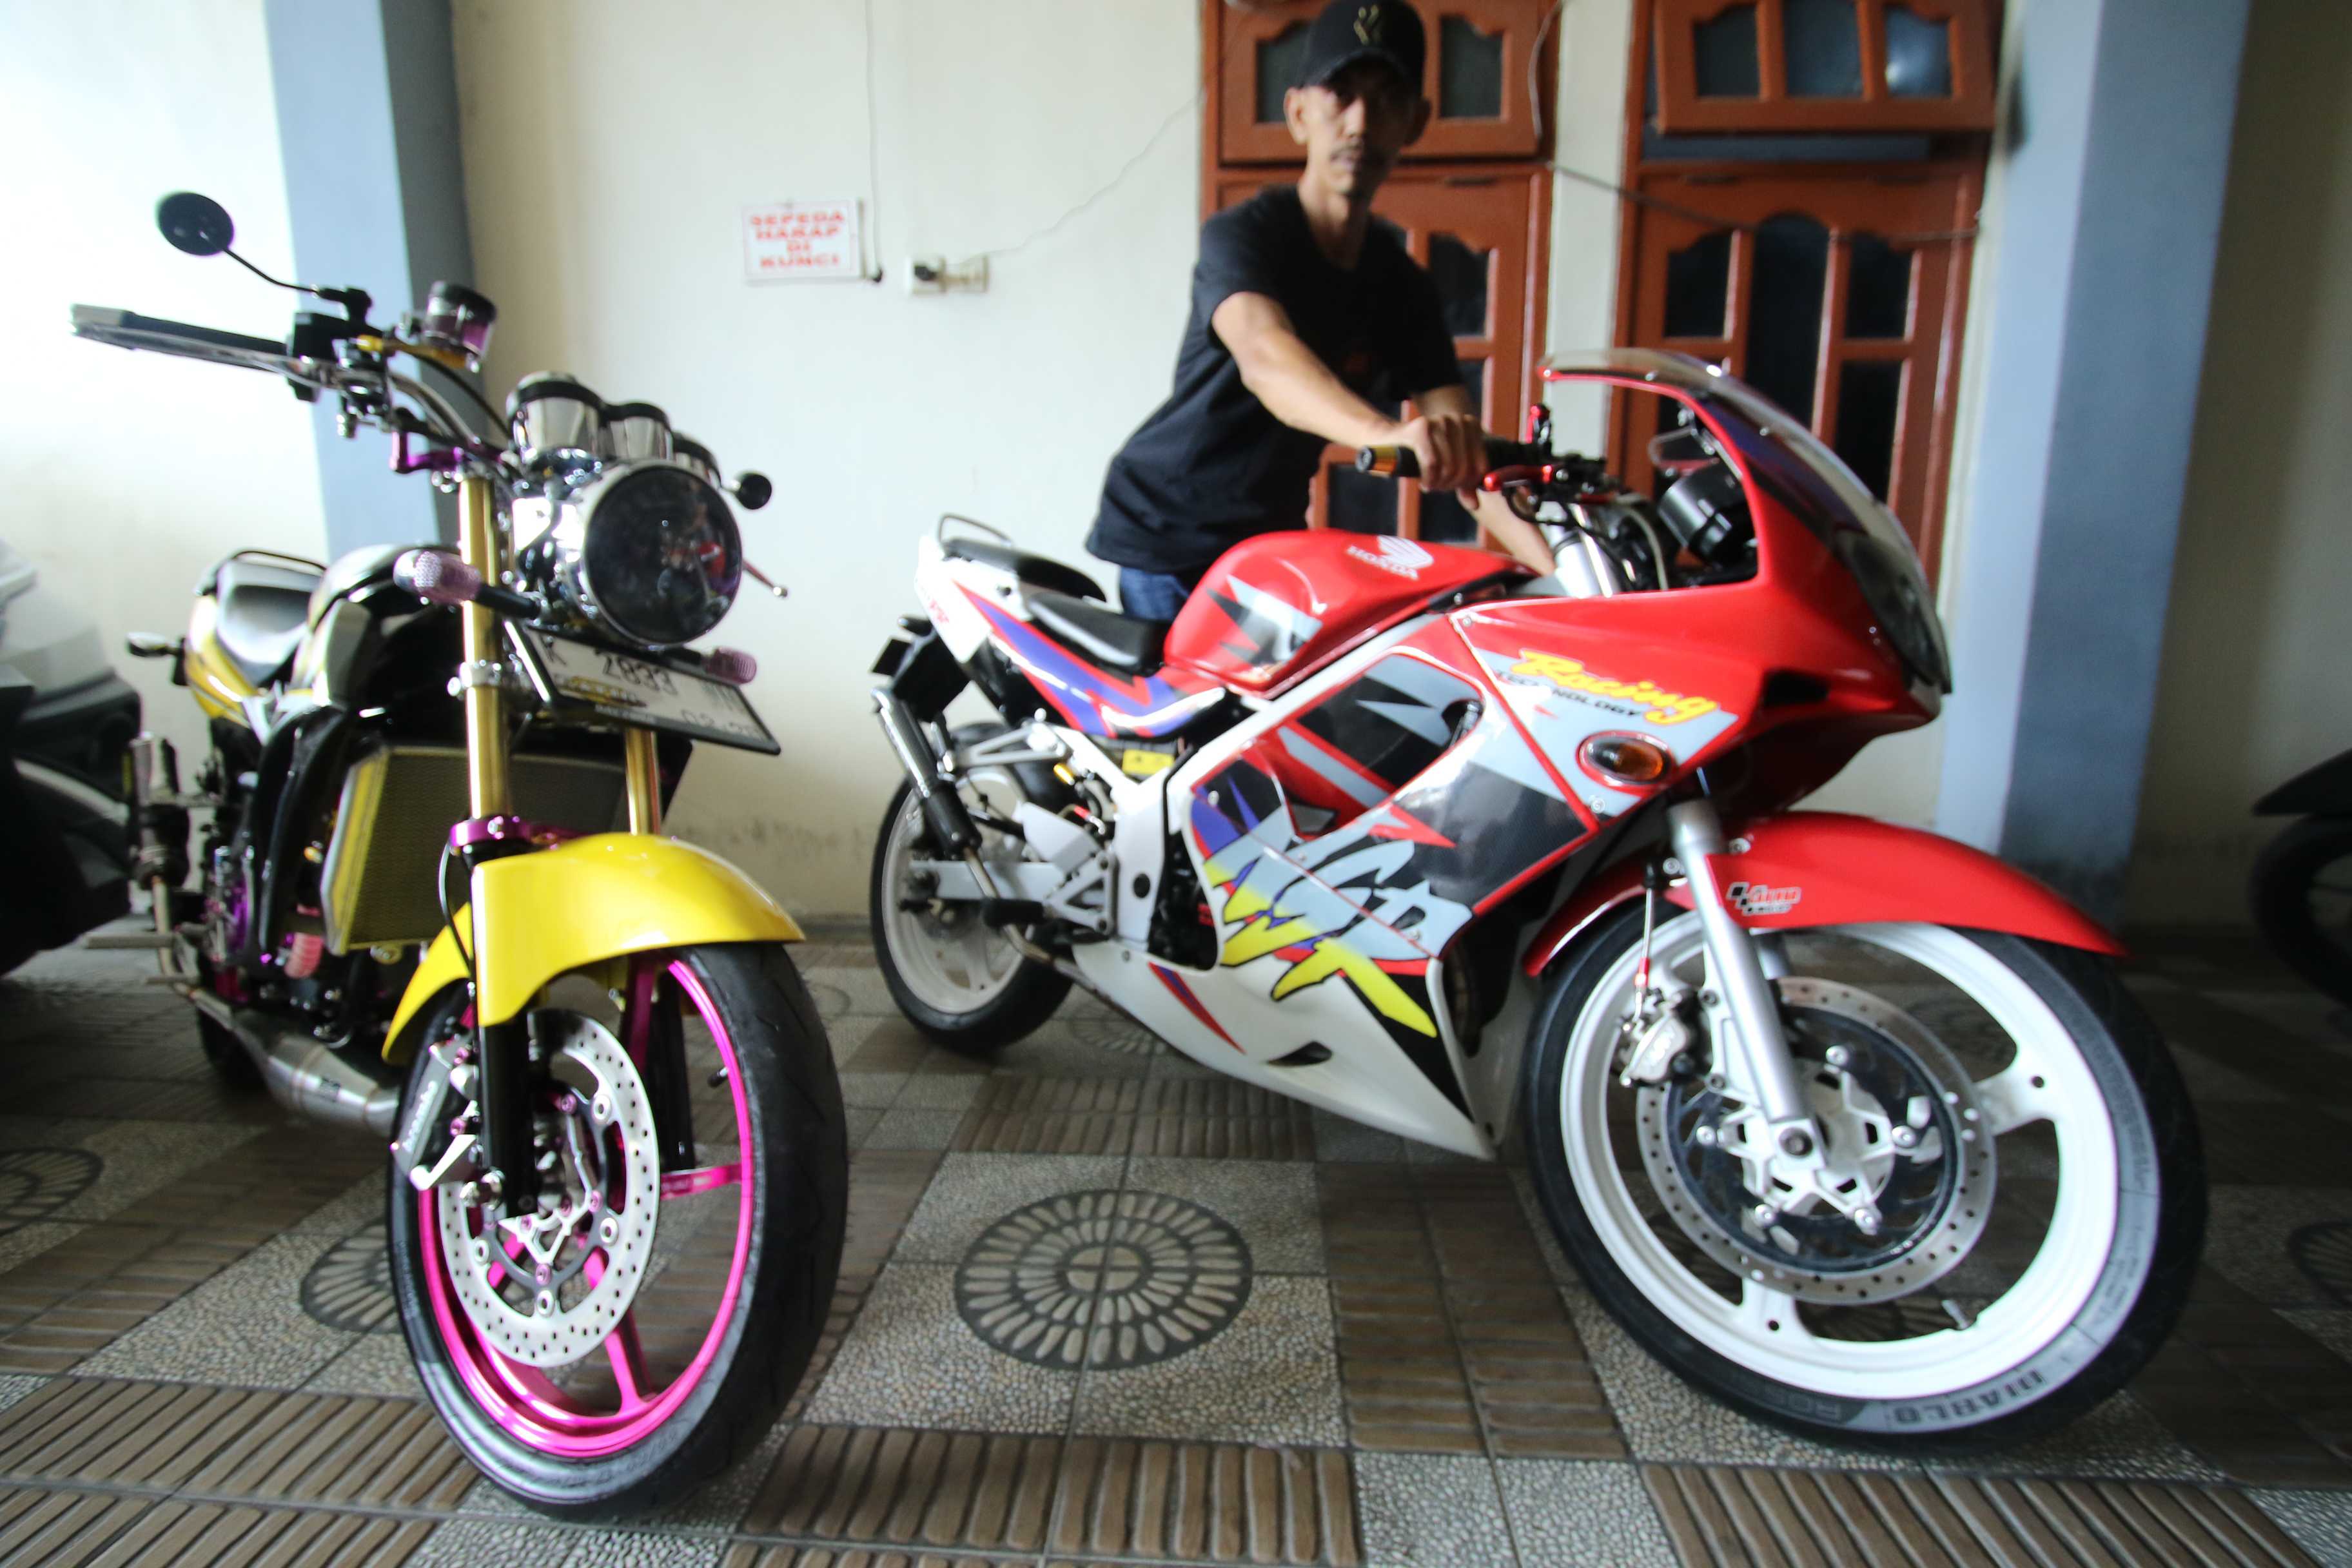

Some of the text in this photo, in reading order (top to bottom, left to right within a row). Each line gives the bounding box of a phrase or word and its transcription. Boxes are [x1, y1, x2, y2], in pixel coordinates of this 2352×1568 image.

[752, 211, 844, 225] SEPEDA
[1346, 545, 1419, 581] HONDA
[1509, 647, 1718, 726] Racing
[1891, 1368, 2045, 1426] DIABLO
